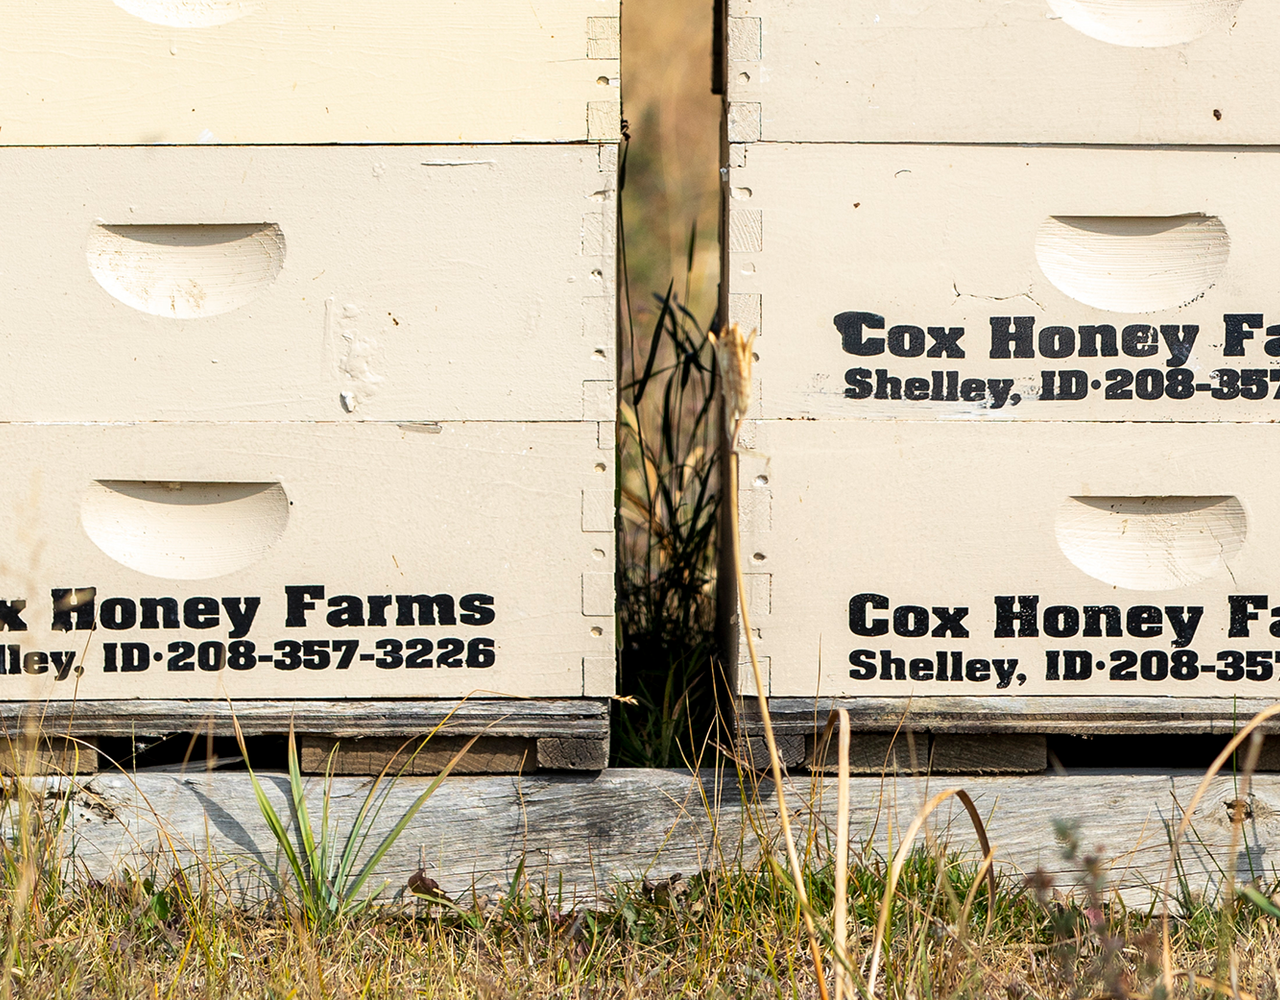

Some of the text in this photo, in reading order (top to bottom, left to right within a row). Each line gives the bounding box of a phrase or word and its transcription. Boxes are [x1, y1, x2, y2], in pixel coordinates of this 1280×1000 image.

[833, 311, 965, 358] Cox
[989, 316, 1199, 367] Honey
[842, 367, 1022, 409] Shelley,
[50, 586, 260, 638] Honey
[284, 585, 495, 627] Farms
[848, 593, 969, 638] Cox
[993, 595, 1203, 648] Honey
[848, 649, 1026, 688] Shelley,
